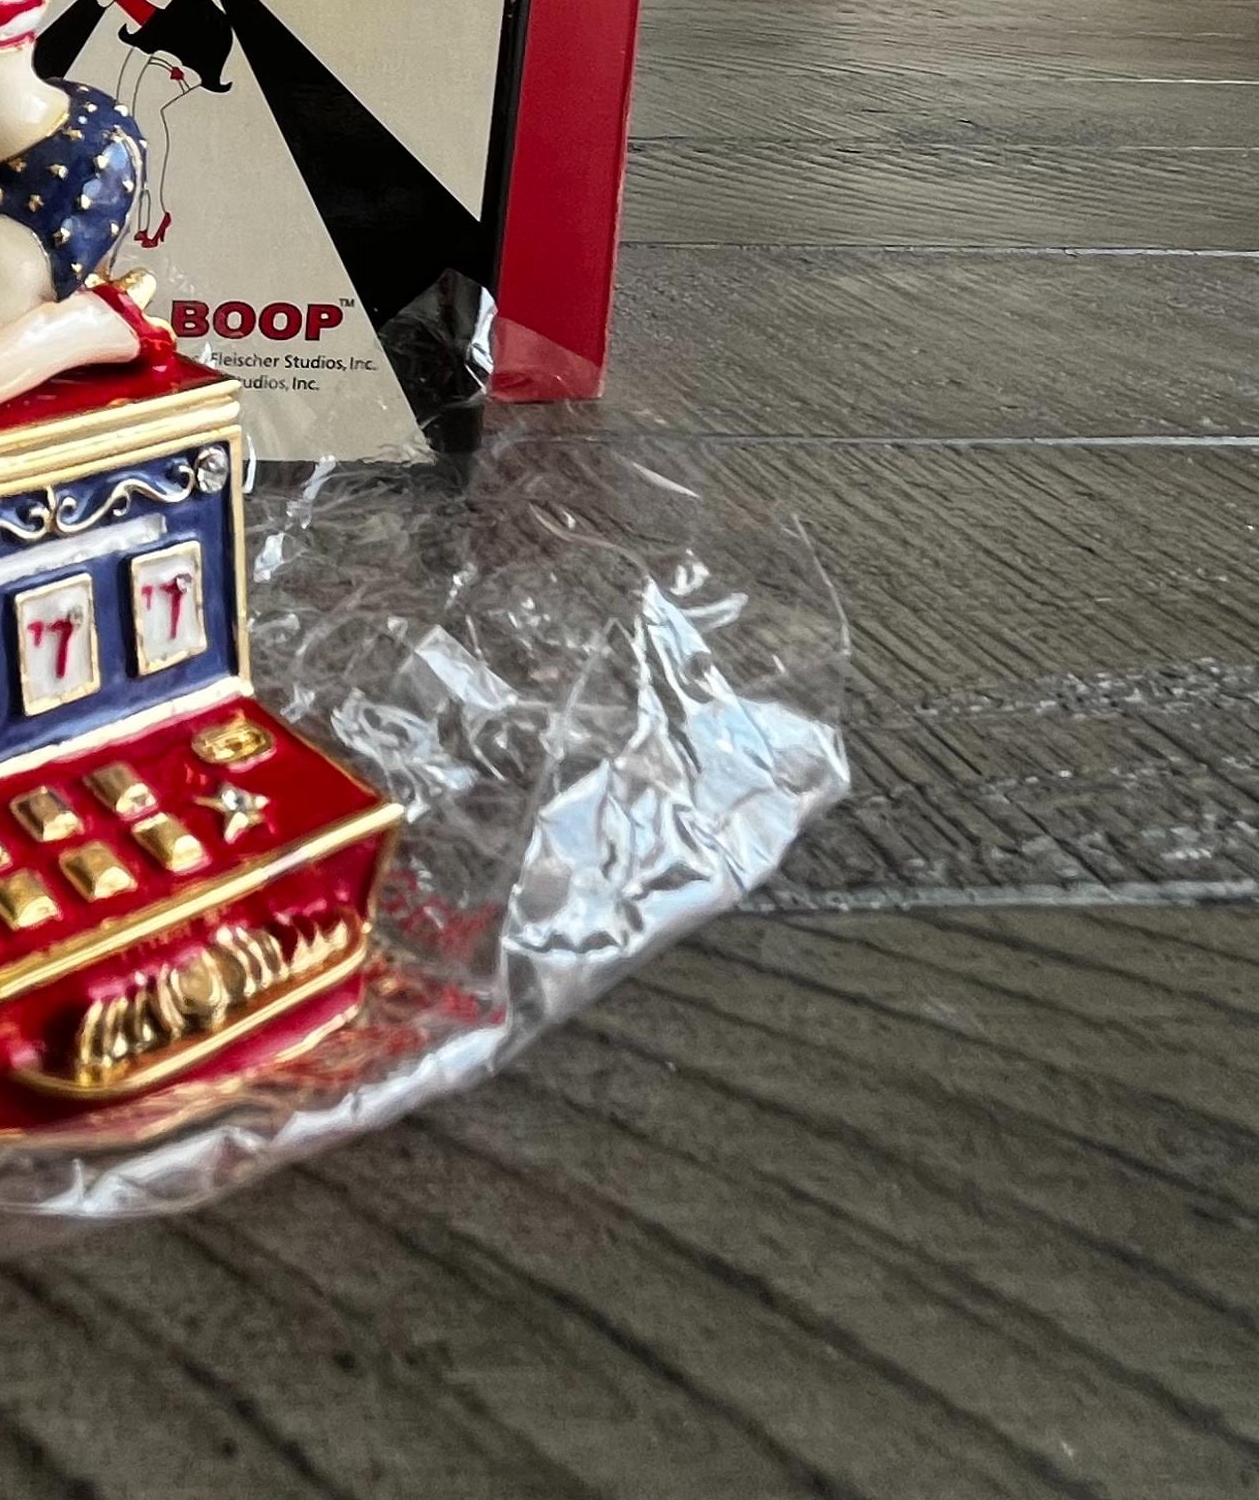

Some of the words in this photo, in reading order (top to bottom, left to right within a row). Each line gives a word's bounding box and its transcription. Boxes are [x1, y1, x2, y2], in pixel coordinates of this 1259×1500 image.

[171, 299, 344, 341] BOOP
[210, 352, 280, 368] Fleischer
[284, 354, 347, 372] Studios,
[349, 356, 377, 372] Inc.
[239, 375, 289, 392] udios,
[292, 377, 320, 391] Inc.
